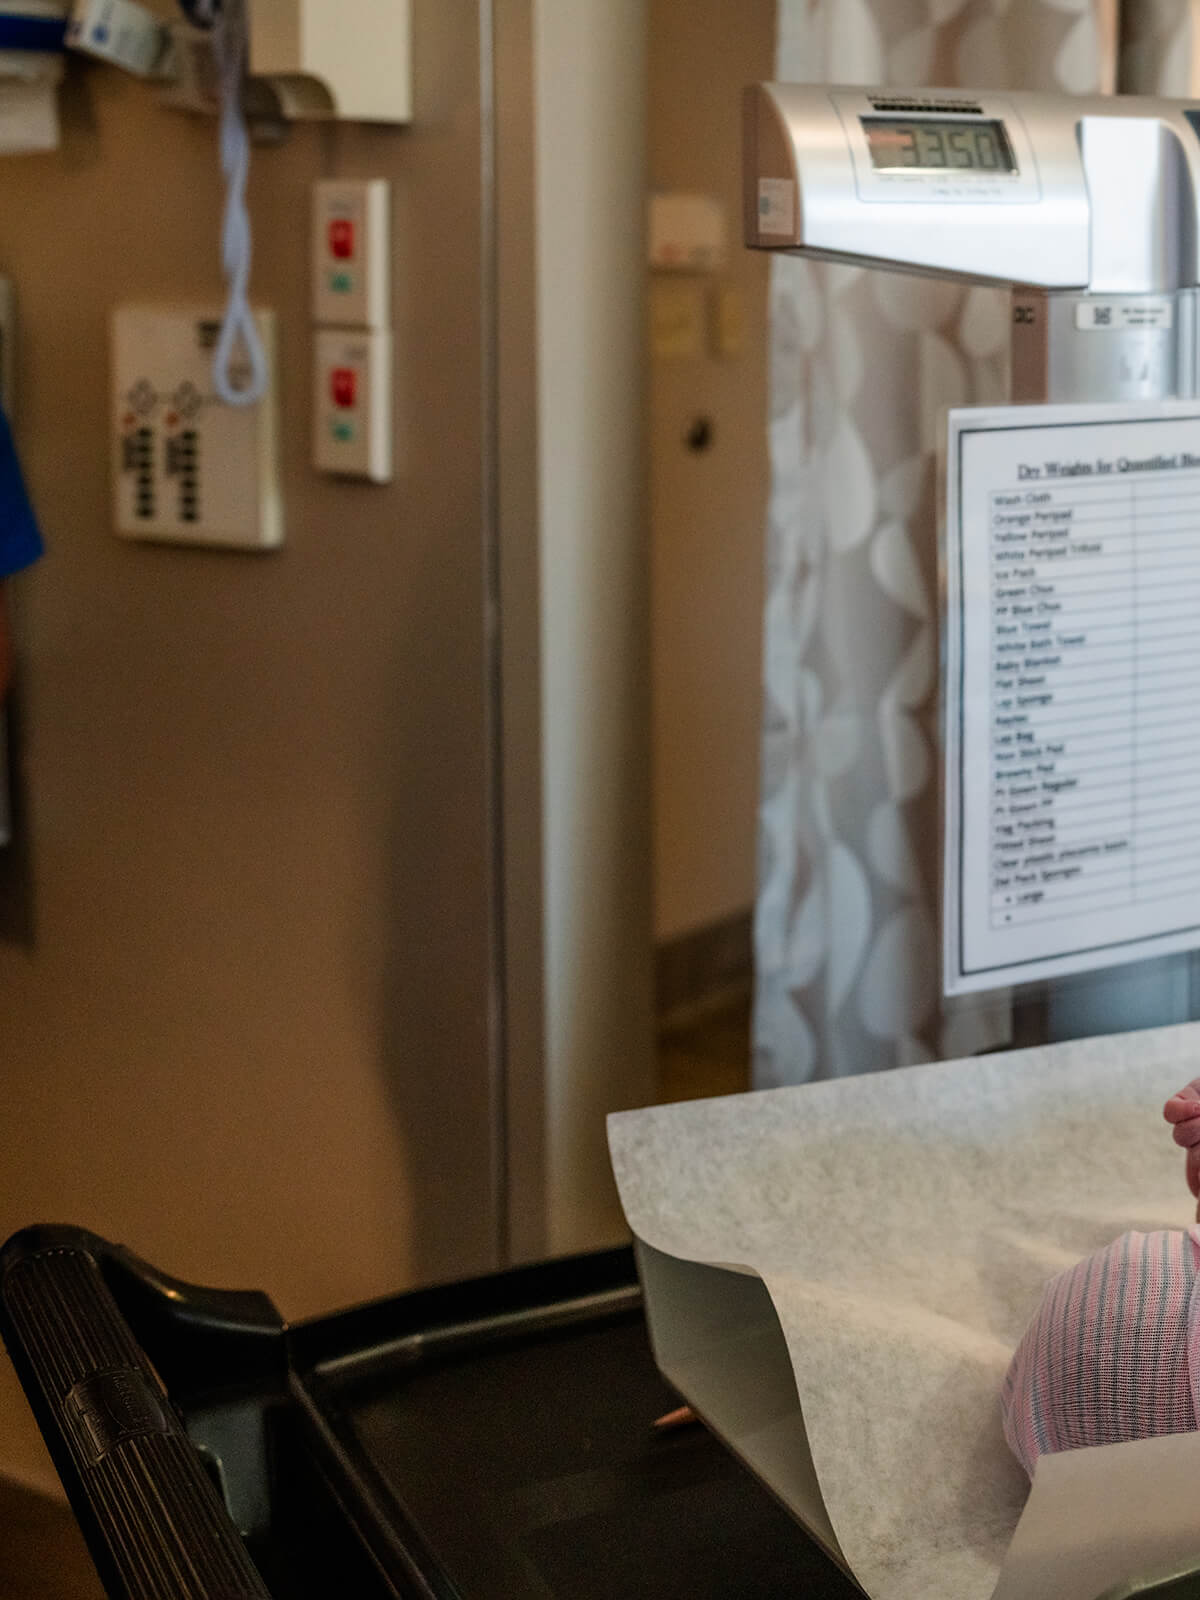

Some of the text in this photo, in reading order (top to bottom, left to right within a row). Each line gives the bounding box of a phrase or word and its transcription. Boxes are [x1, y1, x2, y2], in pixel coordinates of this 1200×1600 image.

[896, 129, 999, 167] 3350
[1018, 464, 1040, 480] Dry
[1045, 461, 1092, 478] Weights
[1097, 460, 1112, 474] for
[1117, 455, 1176, 473] Quantified
